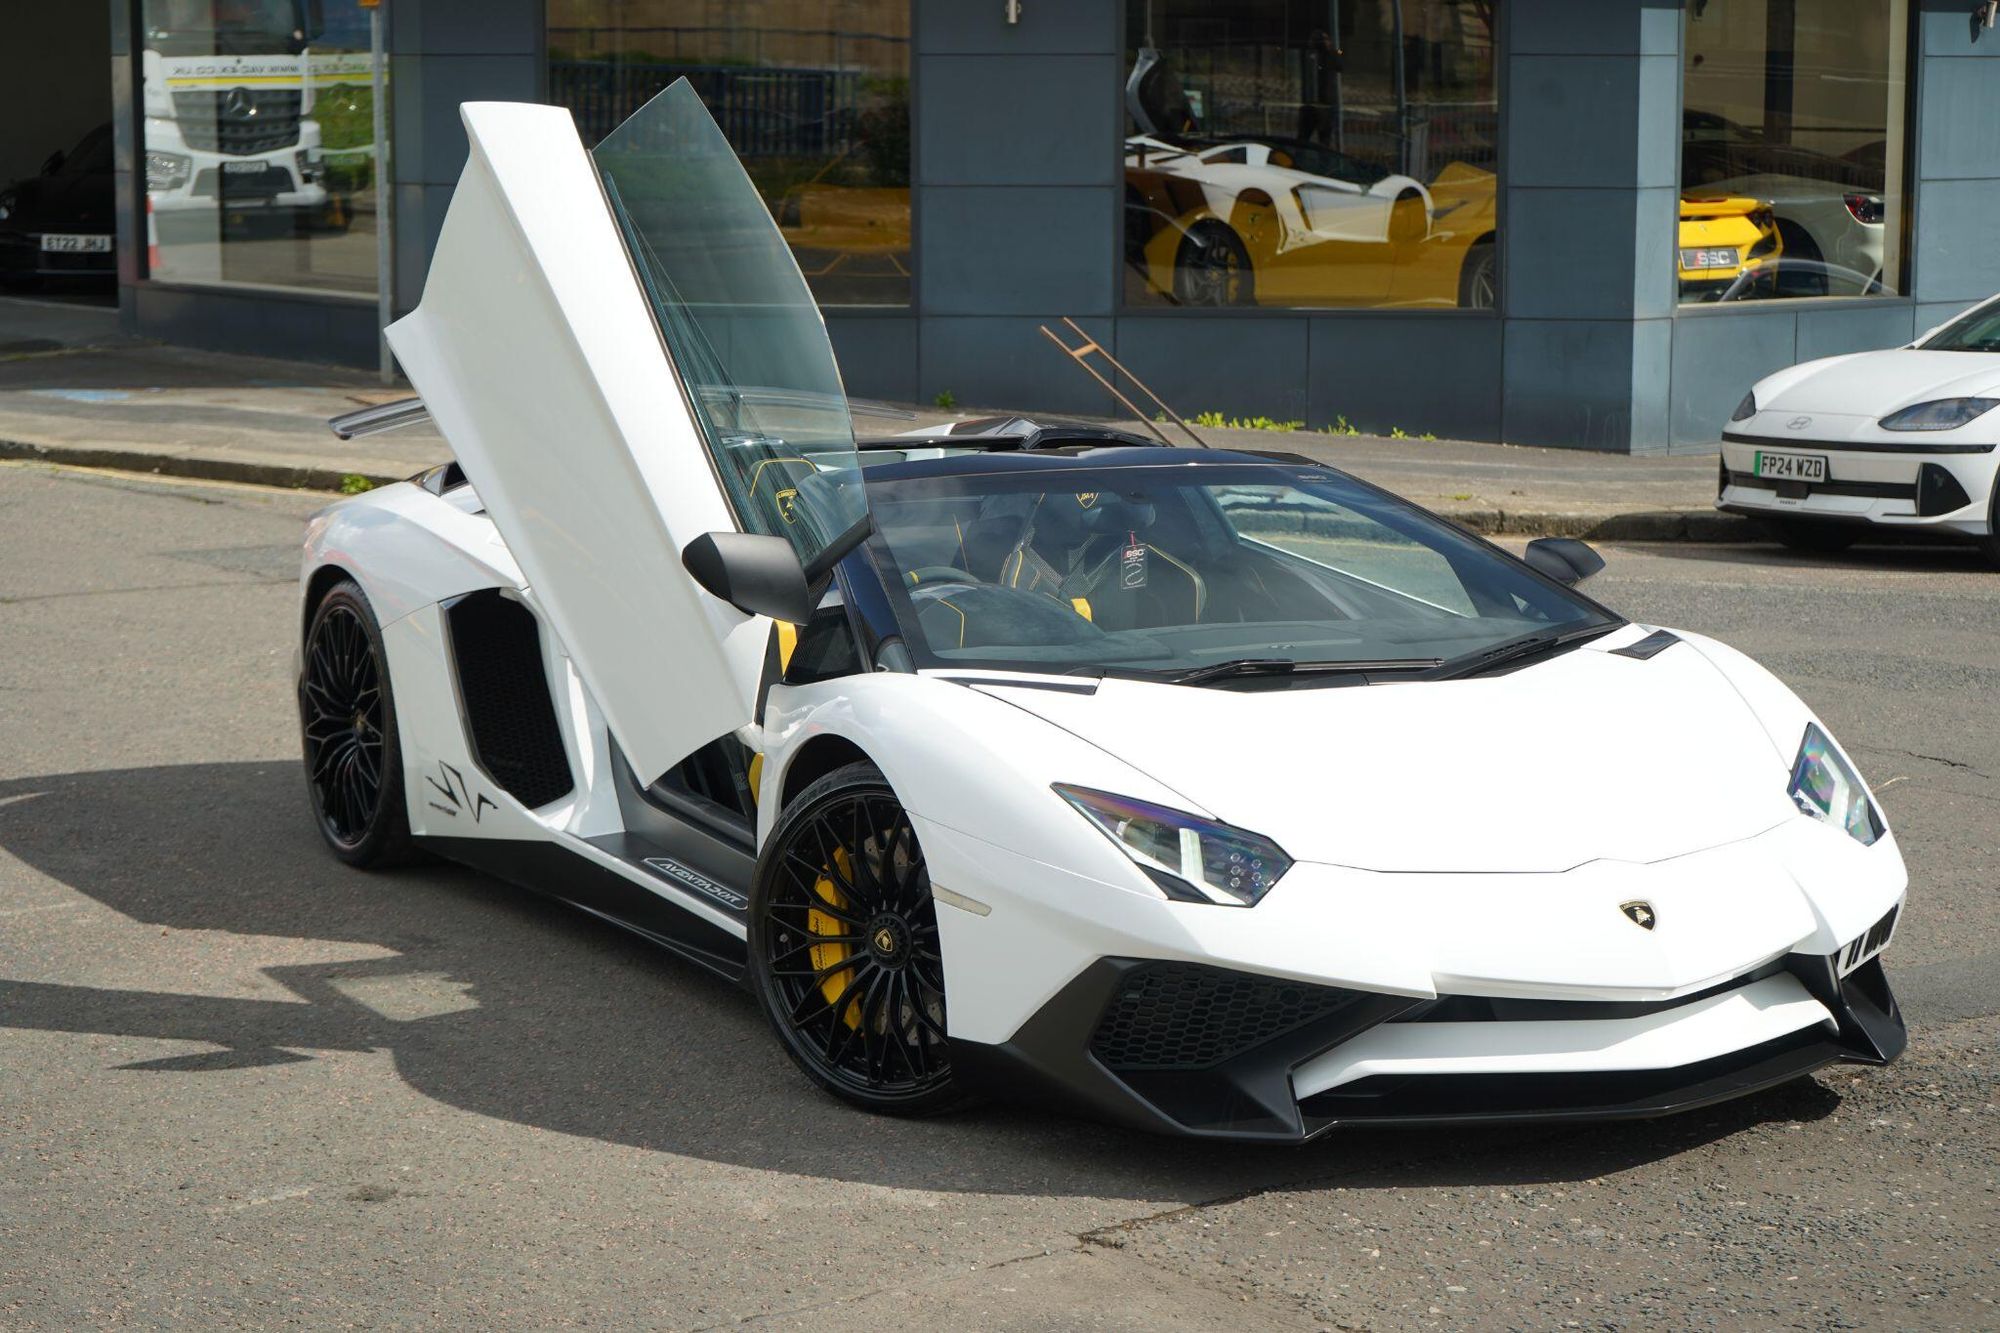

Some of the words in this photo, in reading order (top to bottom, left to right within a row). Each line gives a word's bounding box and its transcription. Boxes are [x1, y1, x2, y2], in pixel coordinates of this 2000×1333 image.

[1696, 250, 1731, 265] SSC
[1761, 456, 1793, 475] FP24
[1796, 459, 1822, 478] WZD
[659, 862, 741, 903] AVENTADOR
